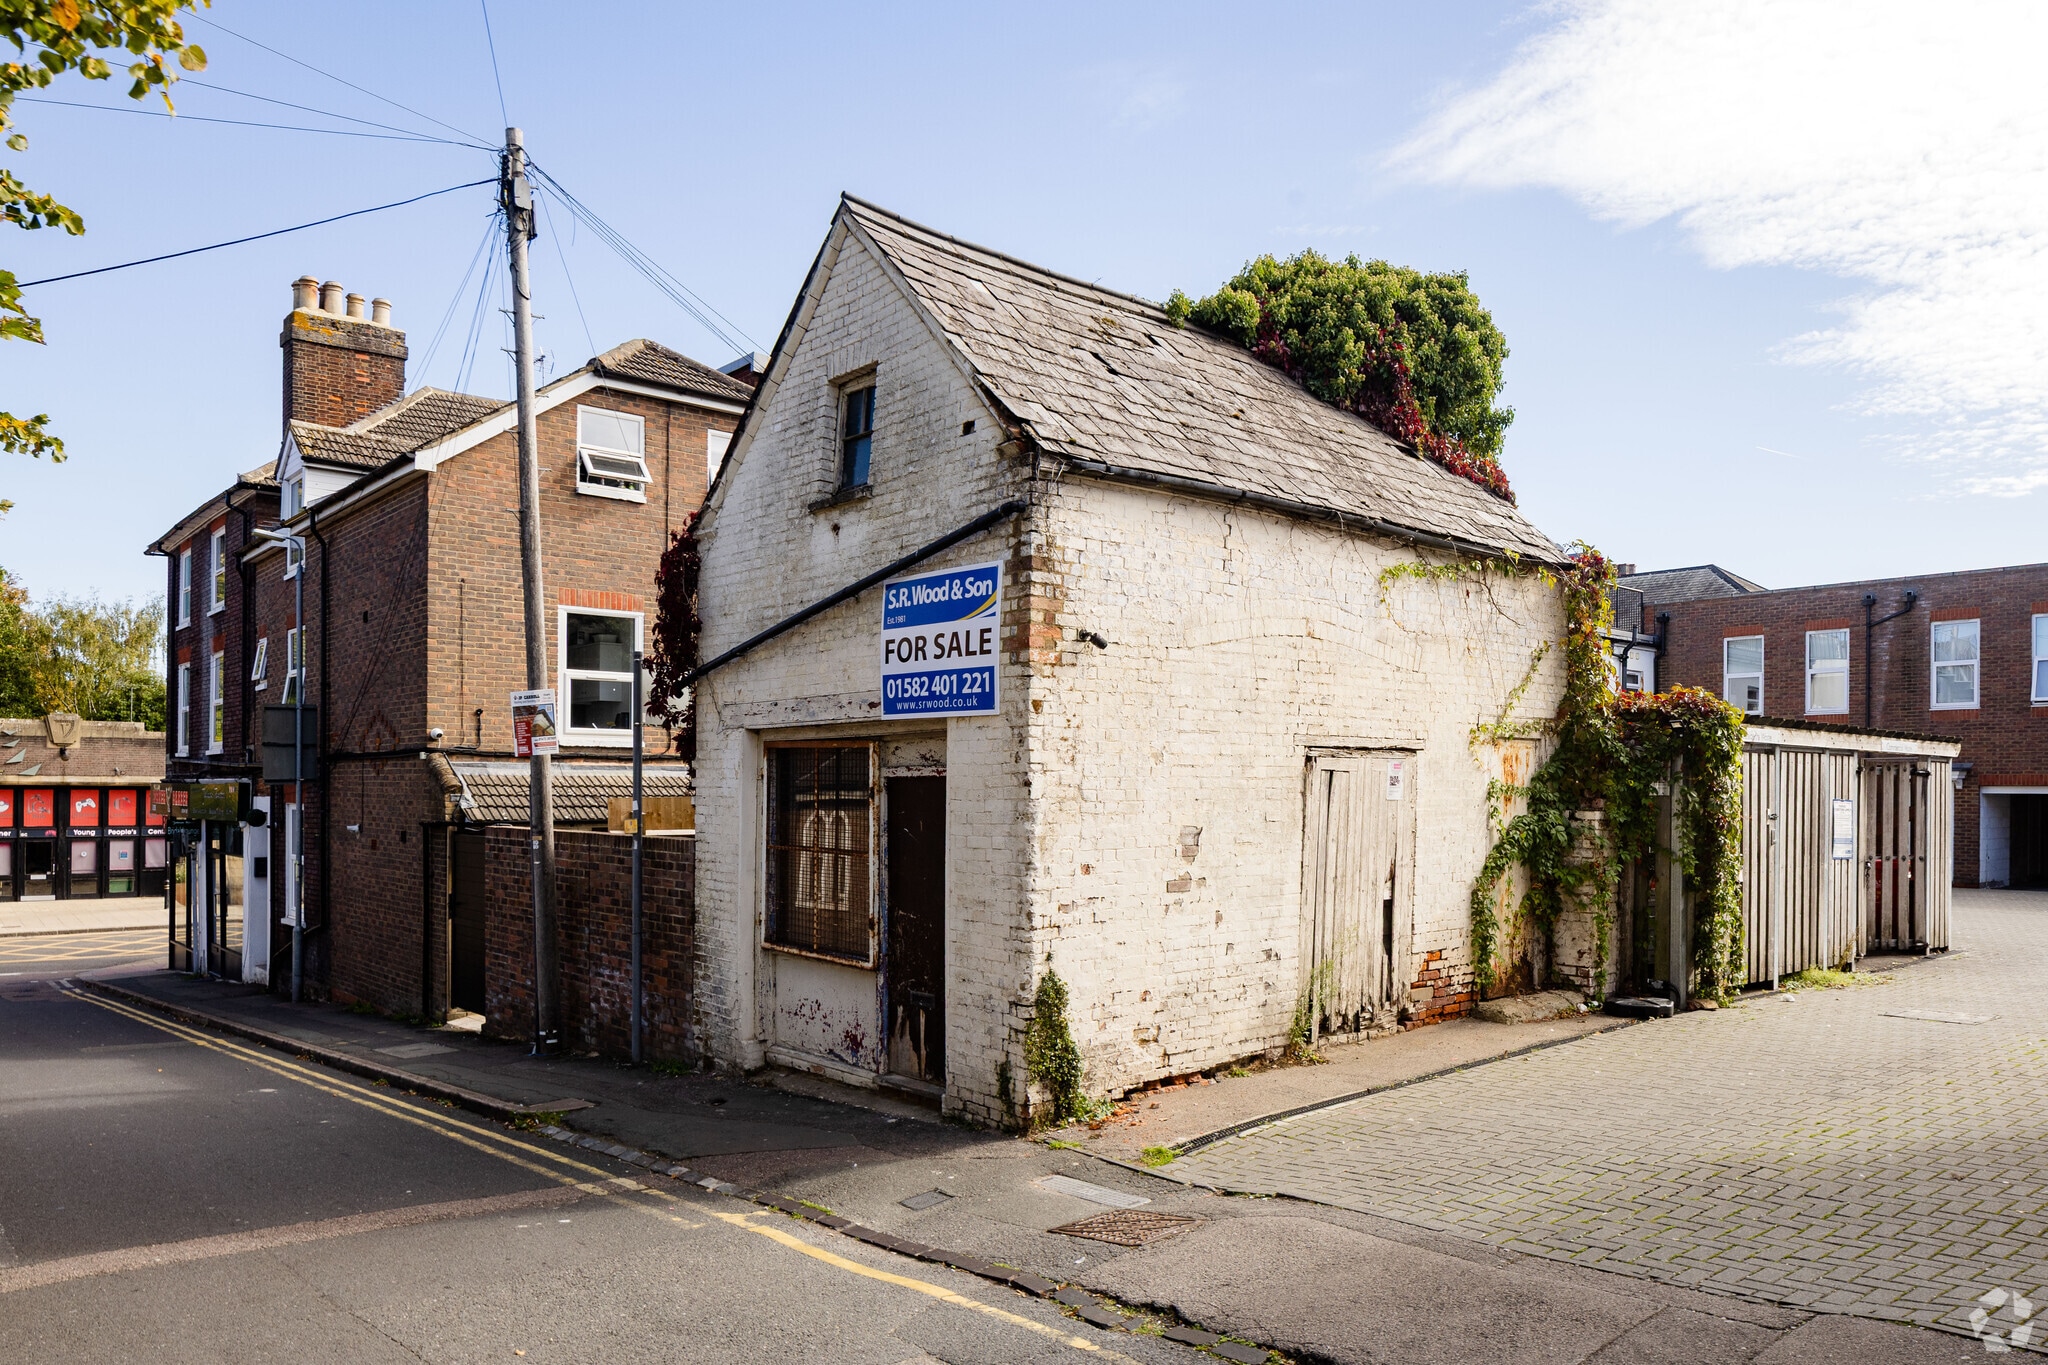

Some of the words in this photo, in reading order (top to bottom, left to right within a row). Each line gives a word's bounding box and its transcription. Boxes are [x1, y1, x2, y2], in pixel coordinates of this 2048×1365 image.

[888, 587, 912, 609] S.R.
[912, 580, 949, 606] Wood
[951, 579, 963, 600] &
[964, 576, 993, 598] Son
[885, 635, 927, 664] FOR
[933, 627, 992, 659] SALE
[887, 676, 929, 698] 01582
[931, 674, 957, 696] 401
[962, 672, 990, 694] 221
[896, 695, 978, 710] www.srwood.co.uk
[73, 829, 96, 837] Young
[147, 828, 165, 836] Cent
